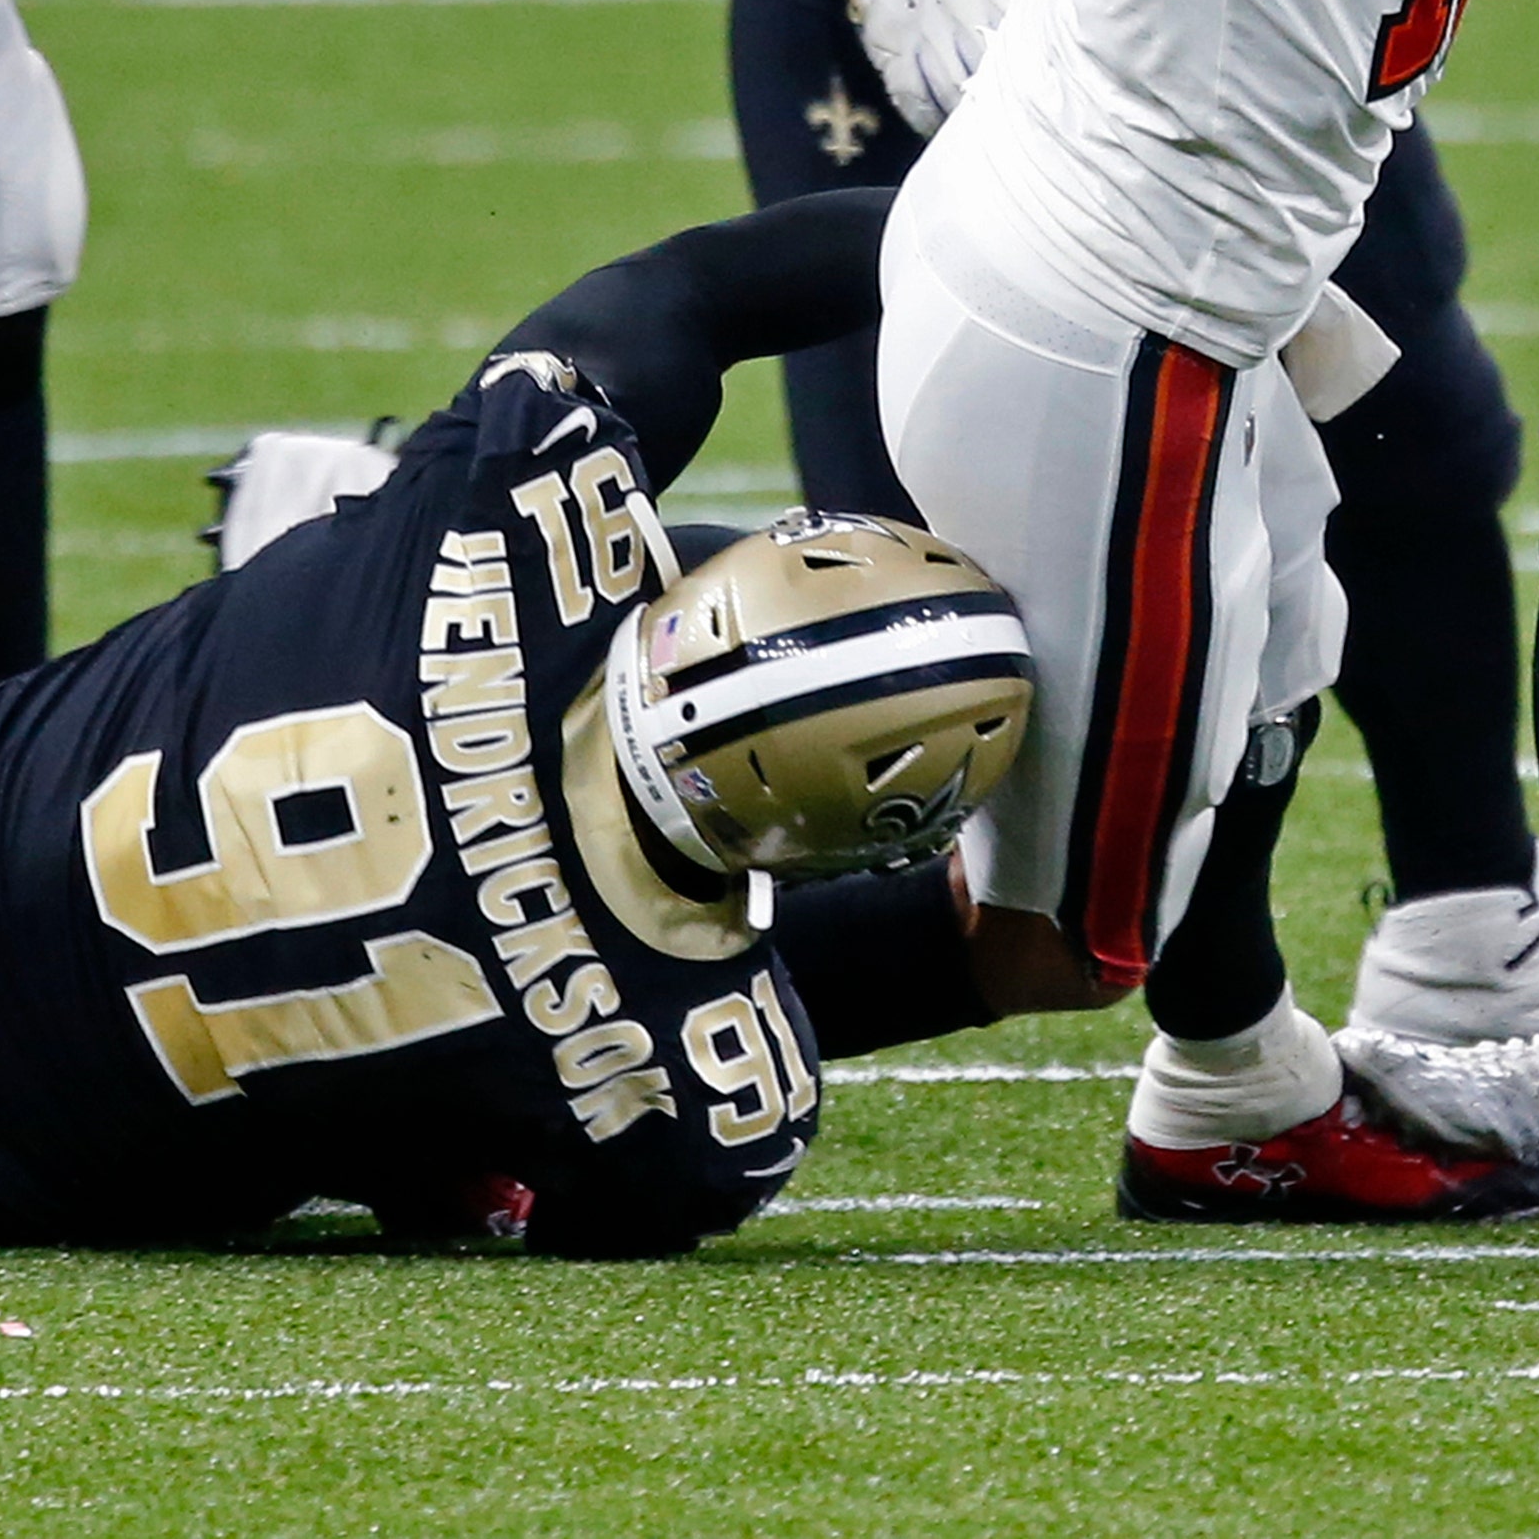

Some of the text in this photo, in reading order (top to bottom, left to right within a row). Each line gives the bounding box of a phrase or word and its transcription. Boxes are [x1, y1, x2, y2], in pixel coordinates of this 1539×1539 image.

[510, 445, 647, 628] 91
[79, 699, 506, 1107] 91
[417, 529, 679, 1146] HENDRICKSON
[679, 969, 817, 1148] 91
